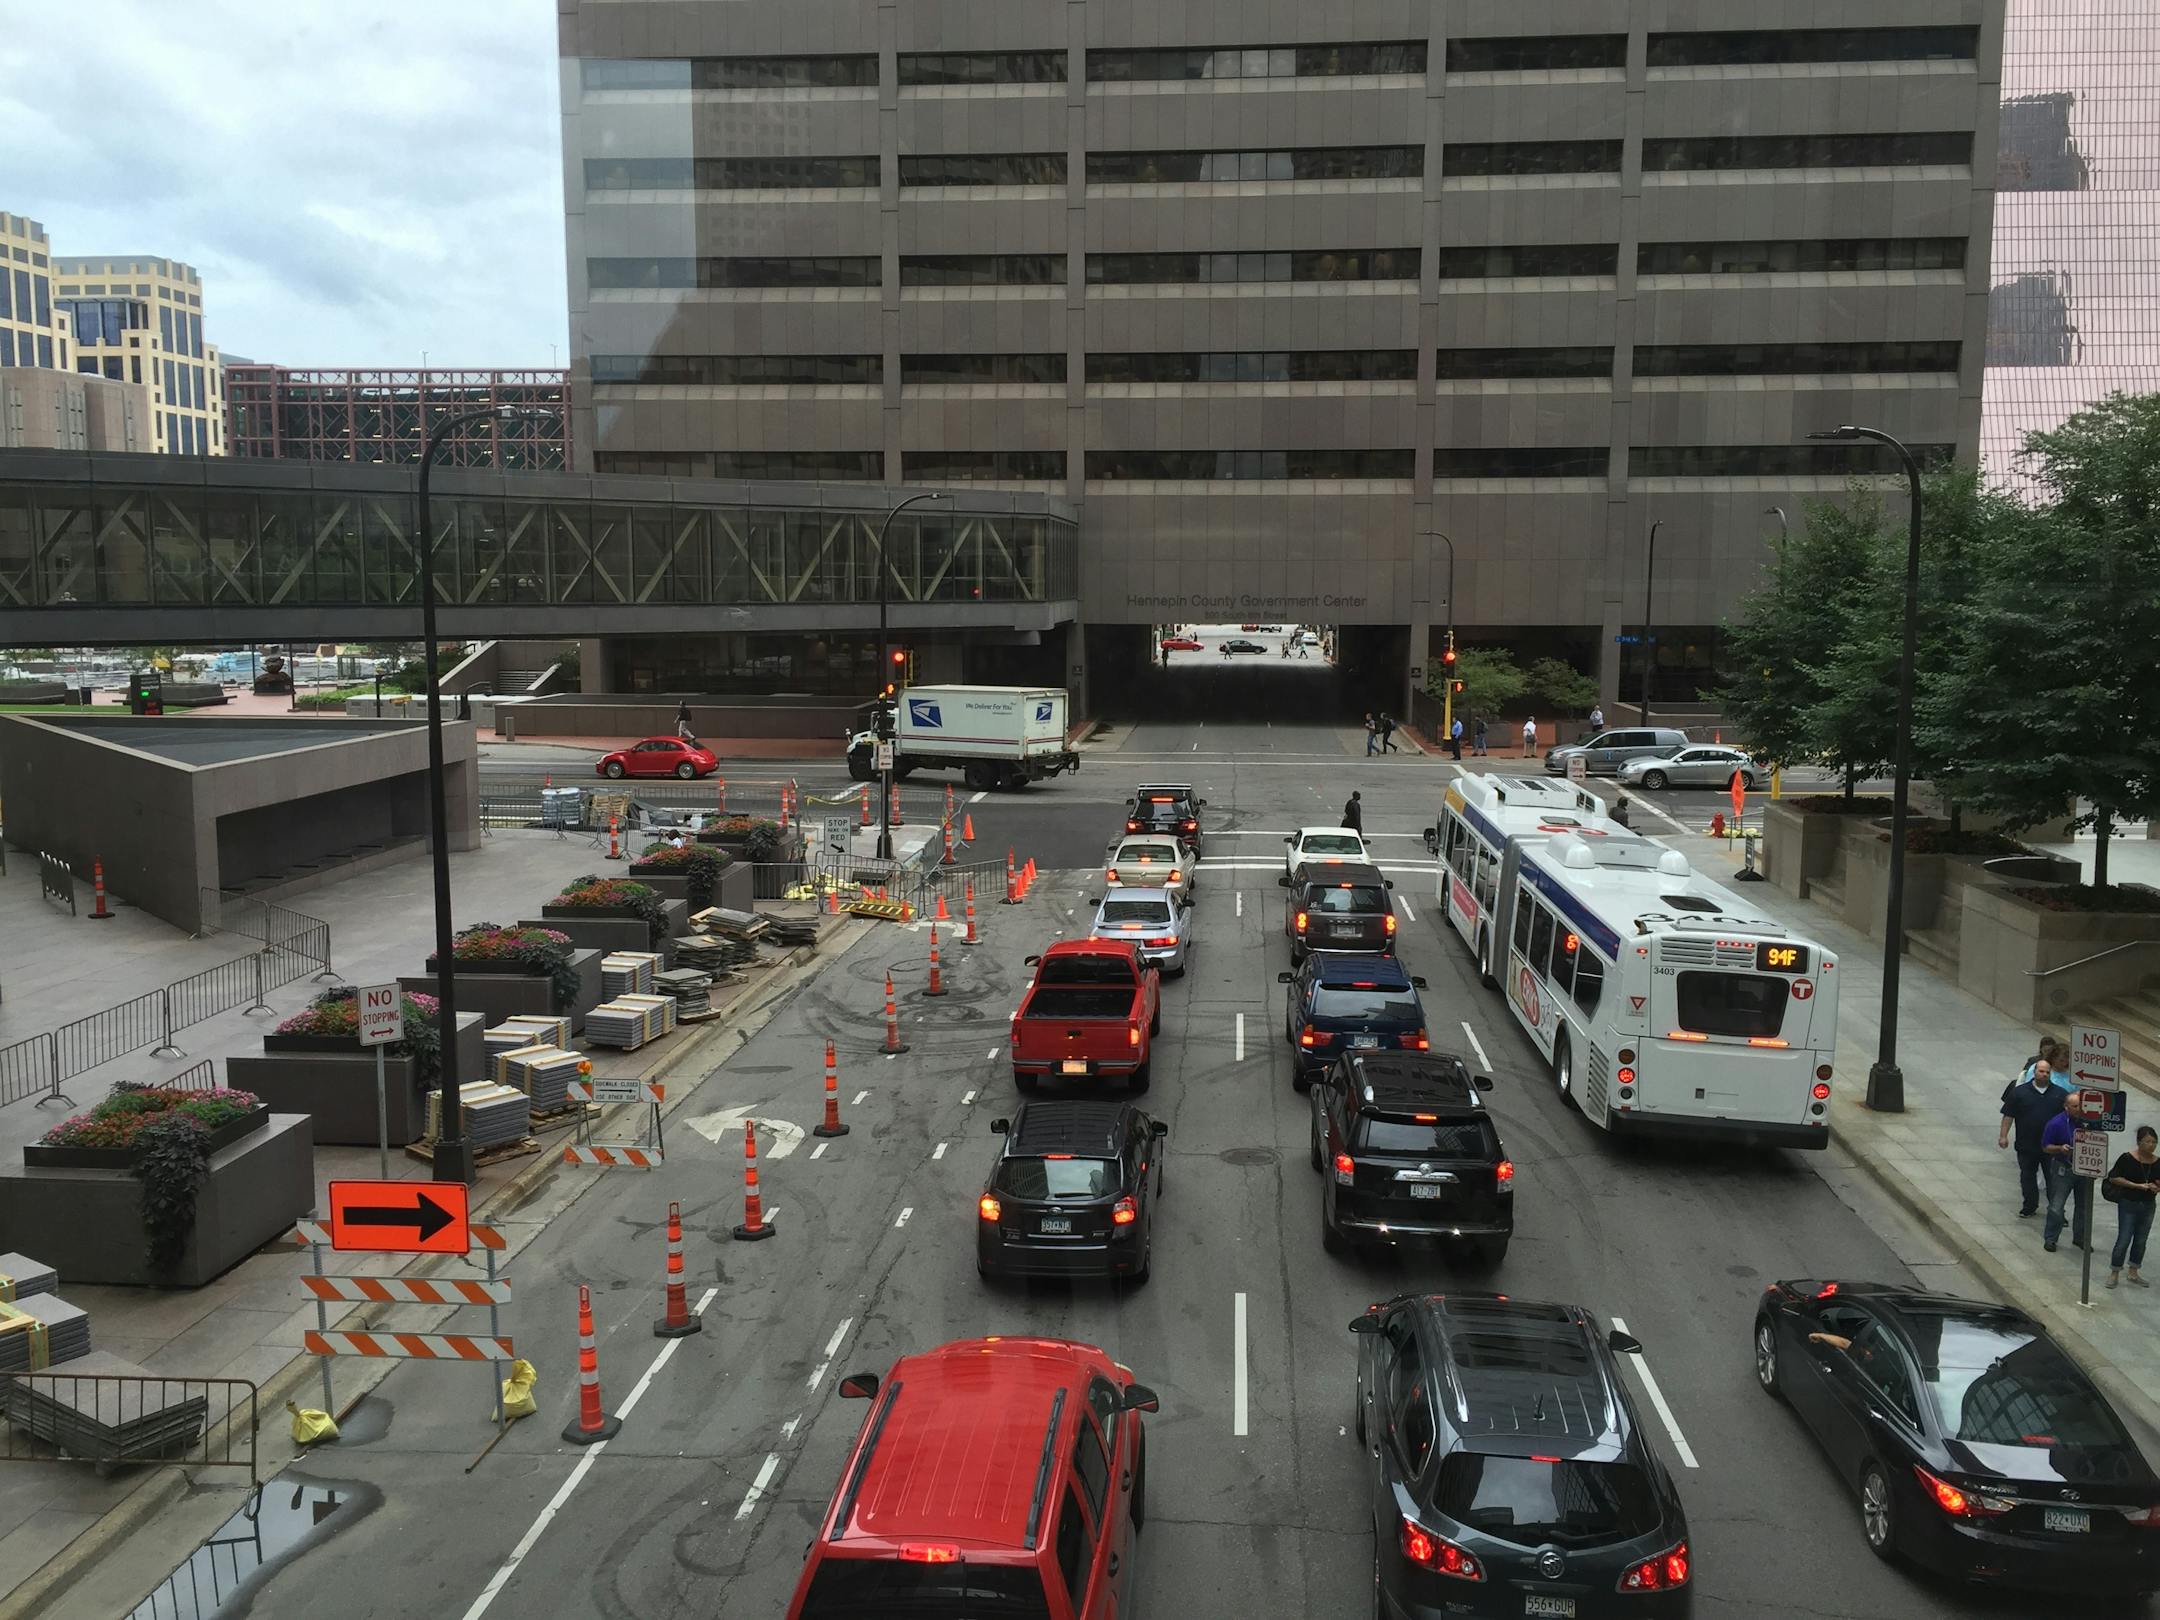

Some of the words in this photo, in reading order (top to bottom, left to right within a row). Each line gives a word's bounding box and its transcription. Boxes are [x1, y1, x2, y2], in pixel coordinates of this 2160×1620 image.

[1127, 594, 1187, 609] Hennepin
[1191, 594, 1236, 609] County
[1240, 594, 1318, 607] Government
[1322, 594, 1367, 607] Center
[828, 819, 848, 827] STOP
[1768, 947, 1797, 967] 94F
[1653, 967, 1675, 976] 3403
[368, 989, 392, 1008] NO
[363, 1010, 400, 1026] STOPPING
[2083, 1033, 2107, 1049] NO
[2074, 1051, 2116, 1068] STOPPING
[2102, 1111, 2120, 1122] Bus
[2102, 1121, 2124, 1132] Stop
[2085, 1132, 2107, 1145] PARKING
[2081, 1145, 2101, 1158] BUS
[2079, 1157, 2103, 1168] STOP
